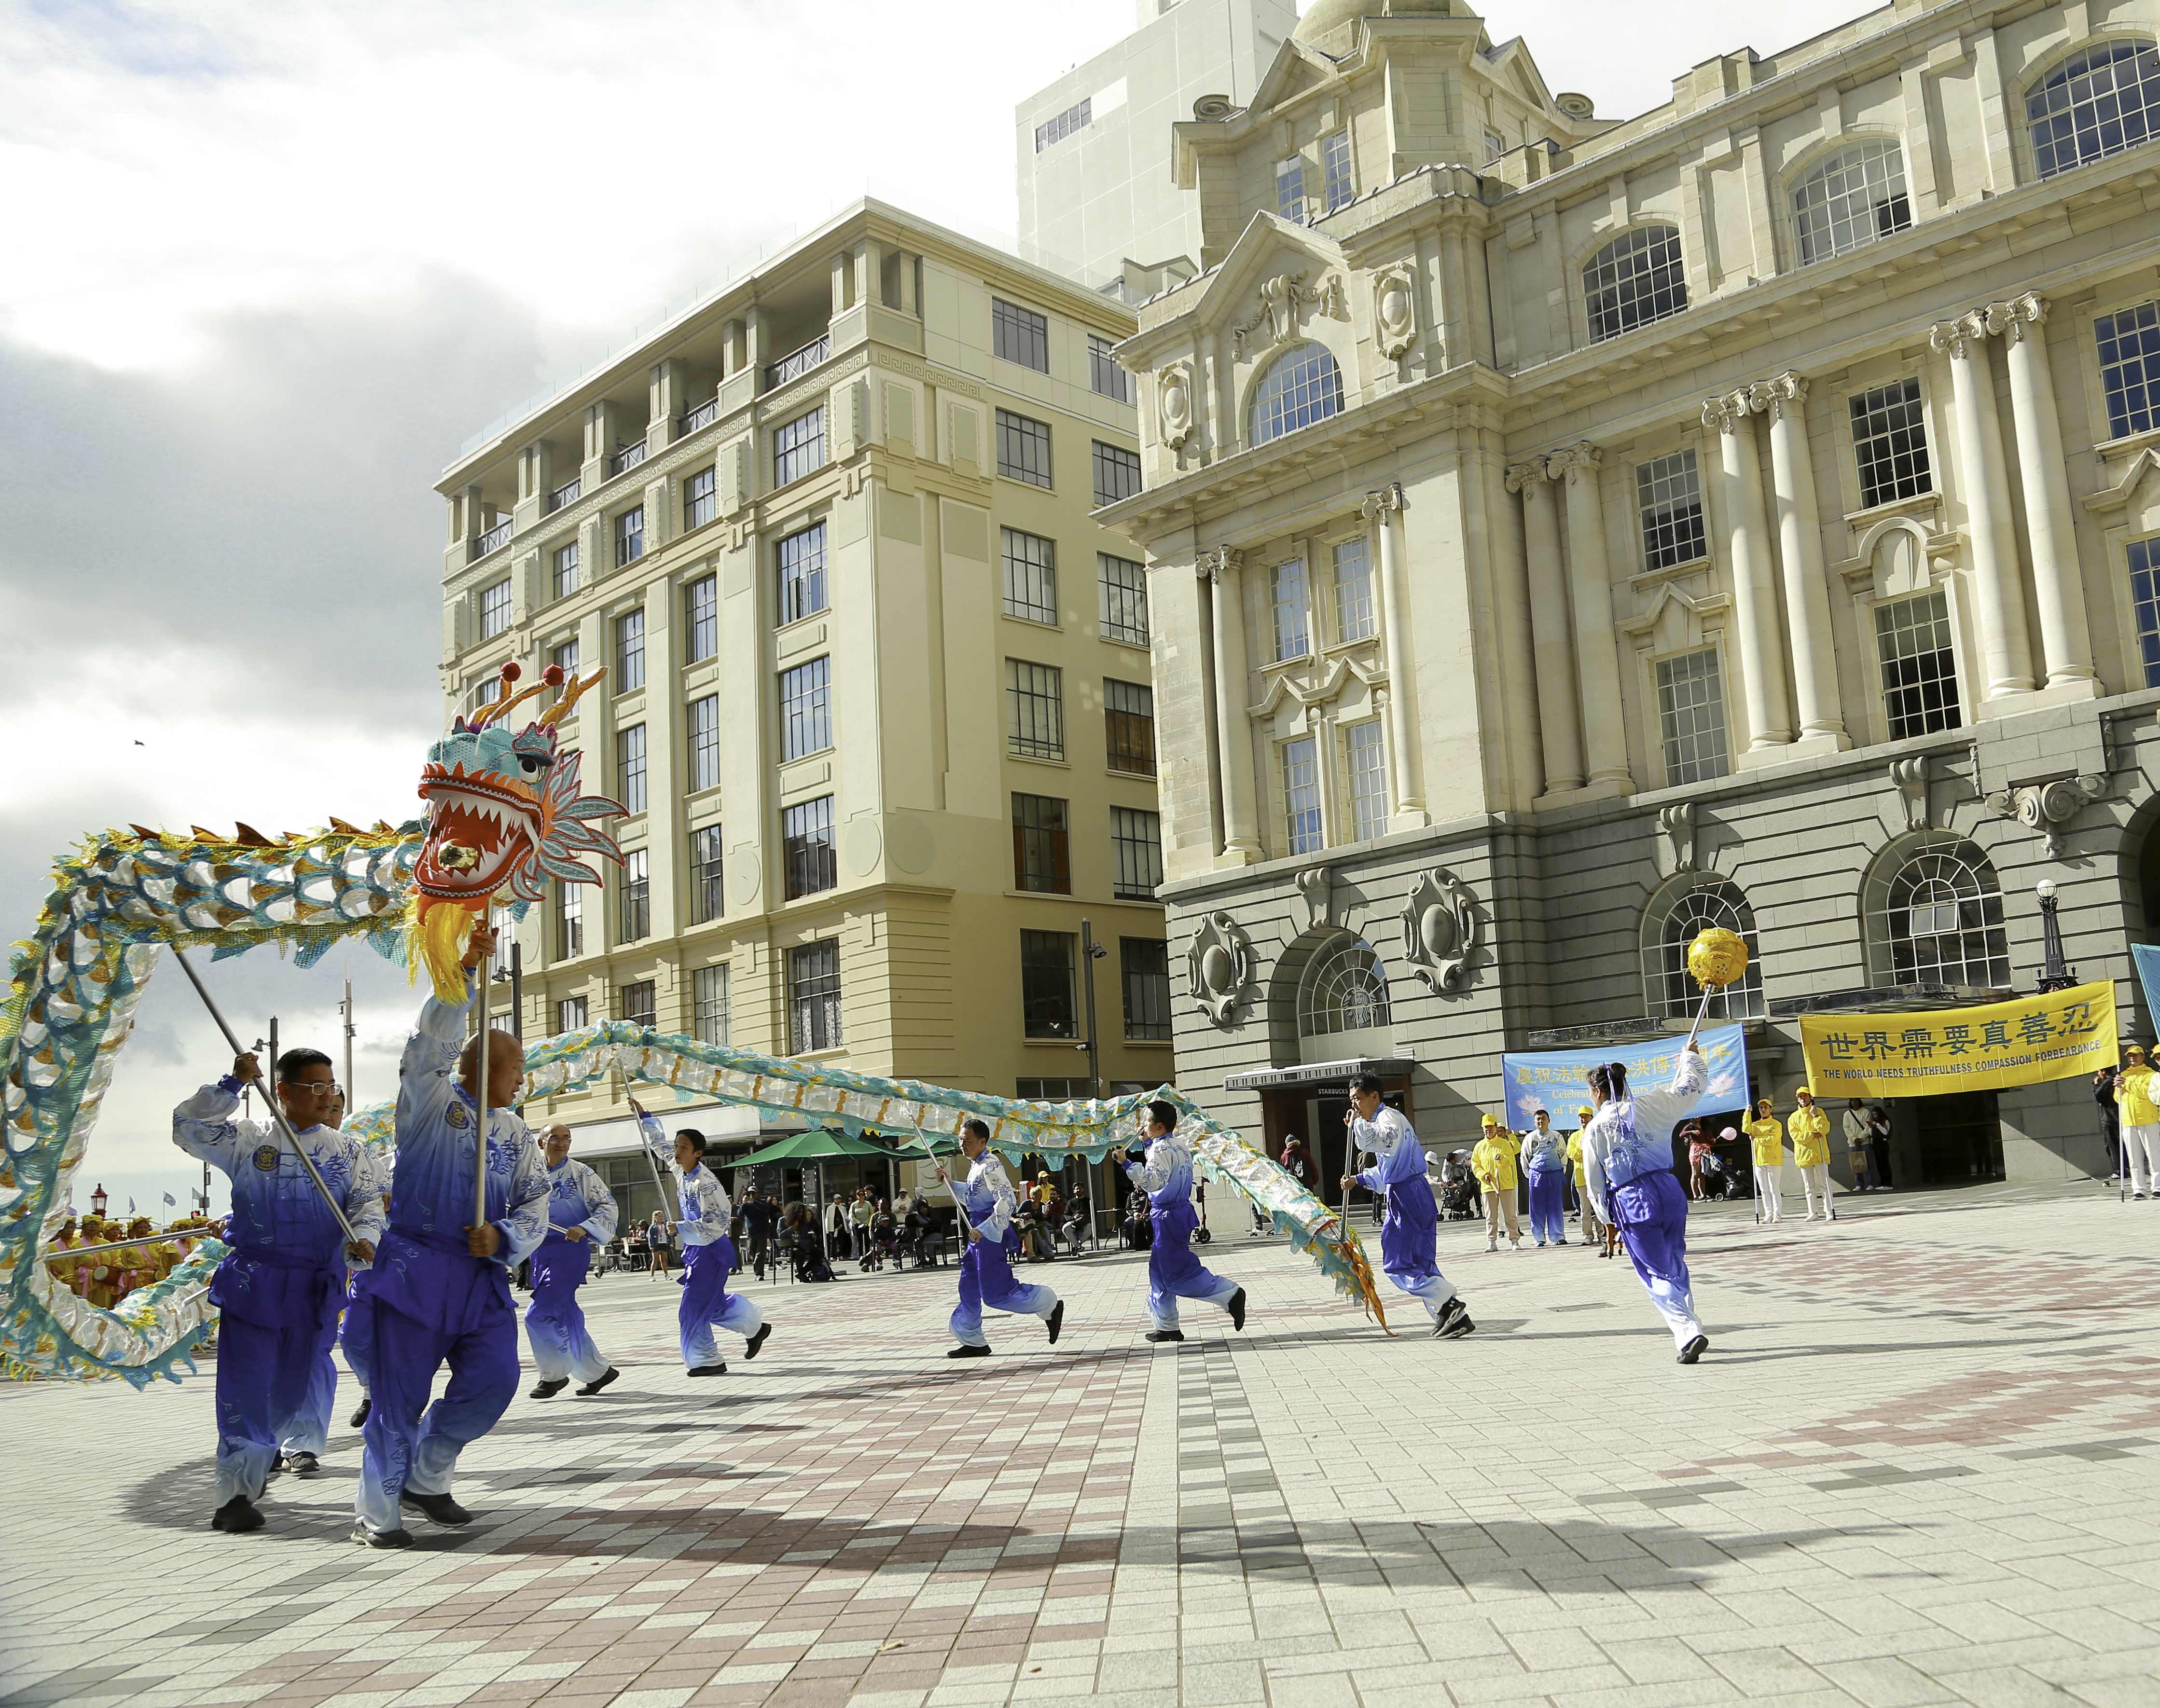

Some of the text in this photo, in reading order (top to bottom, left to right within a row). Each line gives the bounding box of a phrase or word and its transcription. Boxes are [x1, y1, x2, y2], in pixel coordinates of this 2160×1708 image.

[1820, 1002, 2099, 1061] 世界需要真善忍
[1824, 1039, 2101, 1079] THE WORLD NEEDS TRUTHFULNESS COMPASSION FORBEARANCE
[1552, 1089, 1590, 1099] Celebrat
[1629, 1086, 1649, 1095] ears
[1553, 1104, 1565, 1115] of
